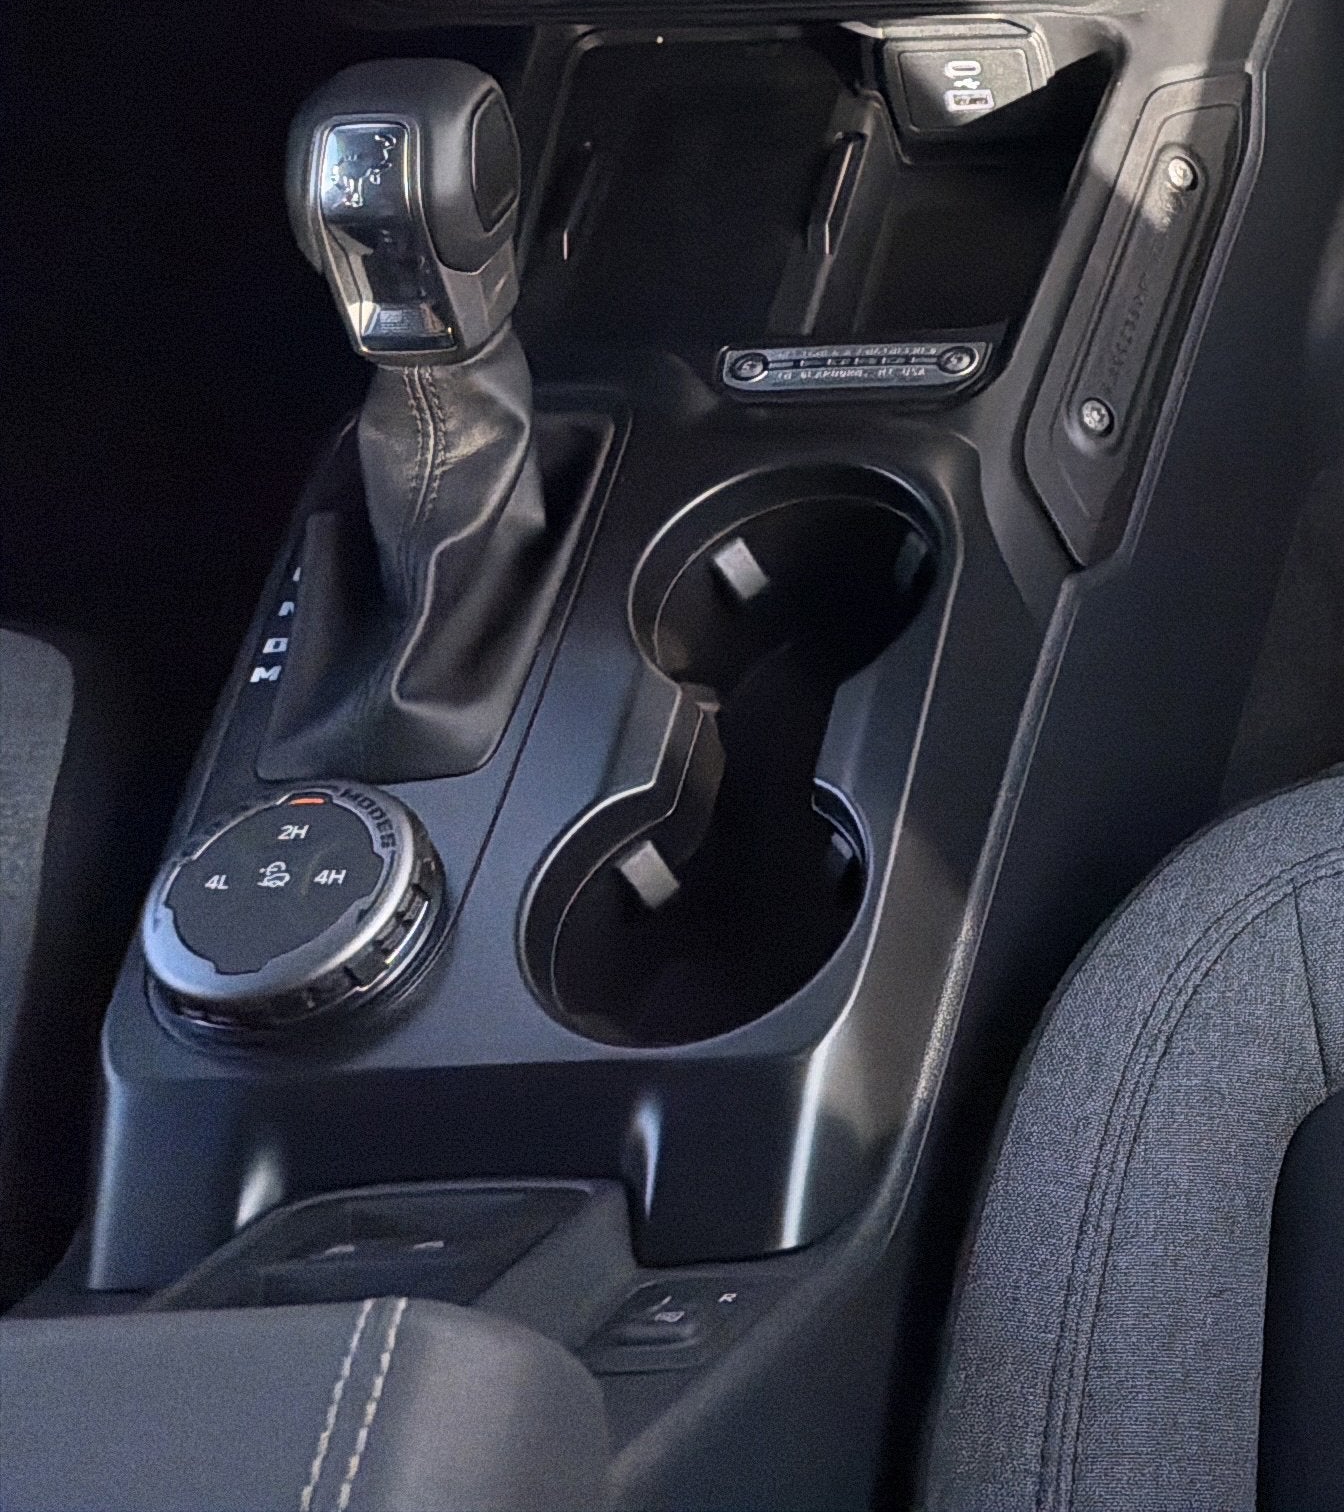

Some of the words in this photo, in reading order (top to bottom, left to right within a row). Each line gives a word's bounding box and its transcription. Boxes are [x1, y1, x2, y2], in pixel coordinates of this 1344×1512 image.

[250, 665, 282, 683] M
[277, 824, 310, 840] 2H
[204, 874, 229, 890] 4L
[313, 869, 347, 885] 4H
